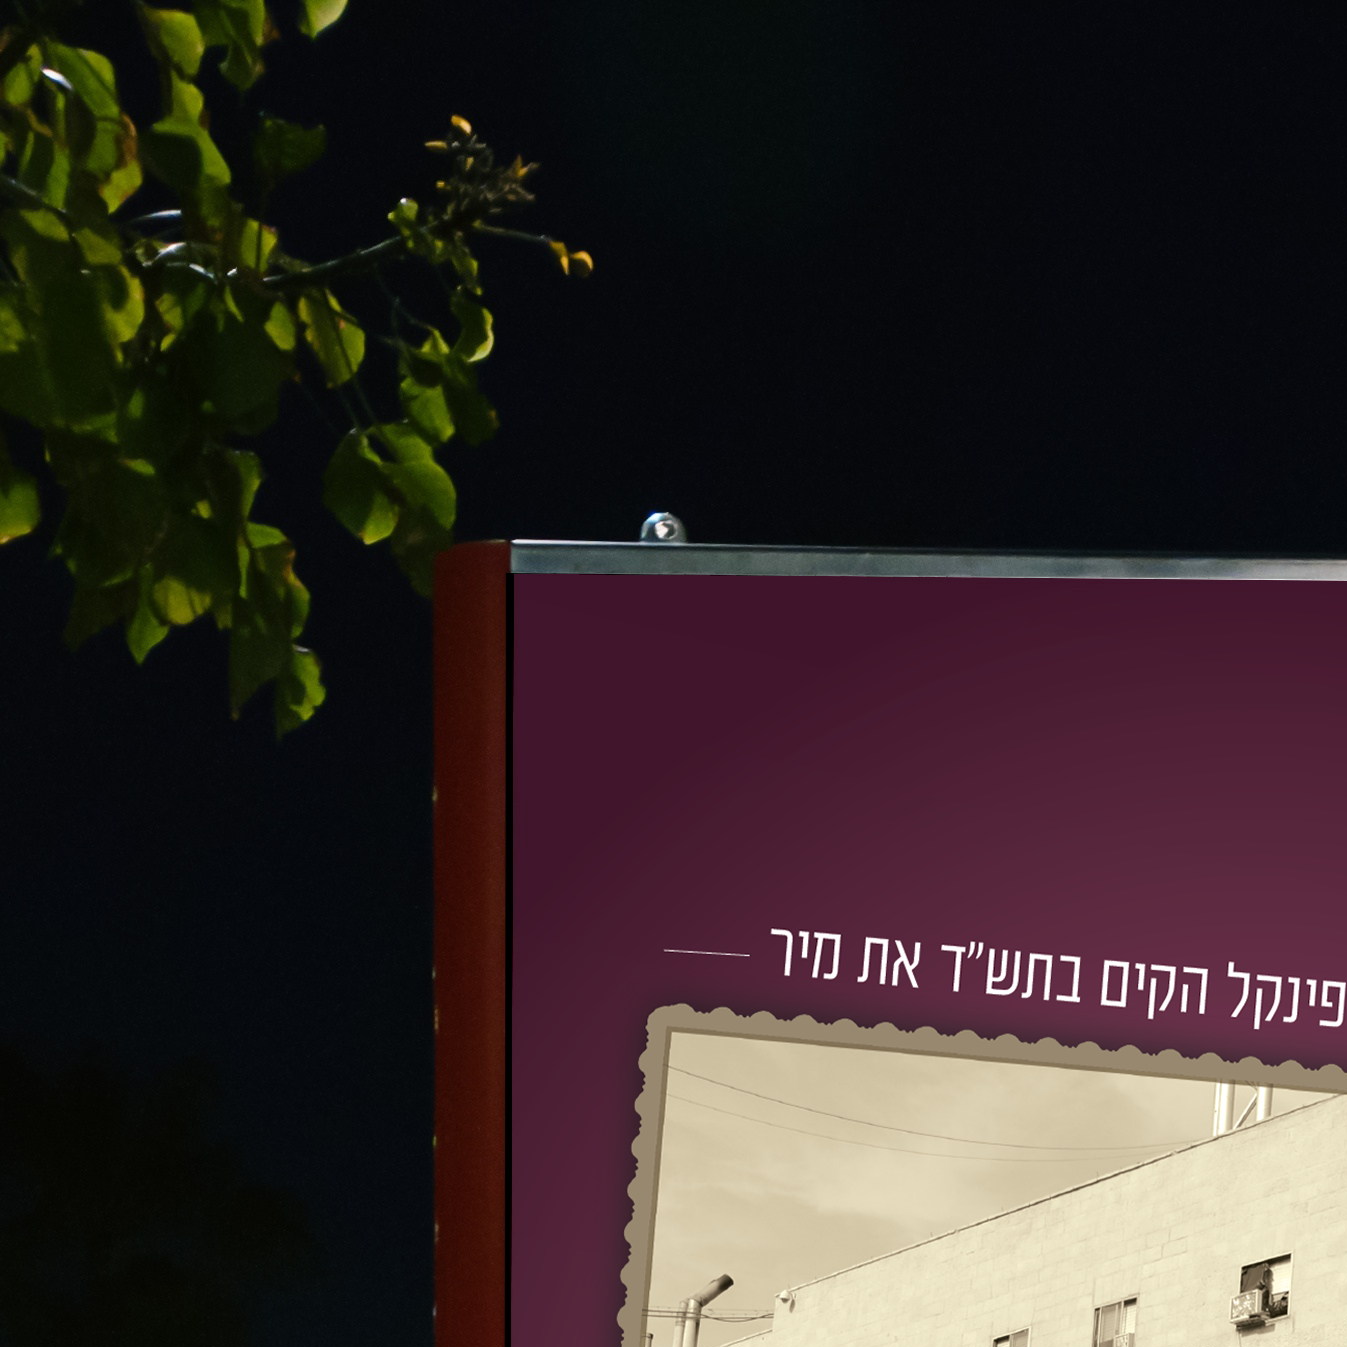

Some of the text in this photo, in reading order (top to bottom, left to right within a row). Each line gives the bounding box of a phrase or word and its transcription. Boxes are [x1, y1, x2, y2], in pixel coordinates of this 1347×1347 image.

[770, 928, 842, 980] מיר
[857, 936, 921, 989] את
[1100, 959, 1209, 1020] הקים
[1227, 961, 1347, 1030] פינקל
